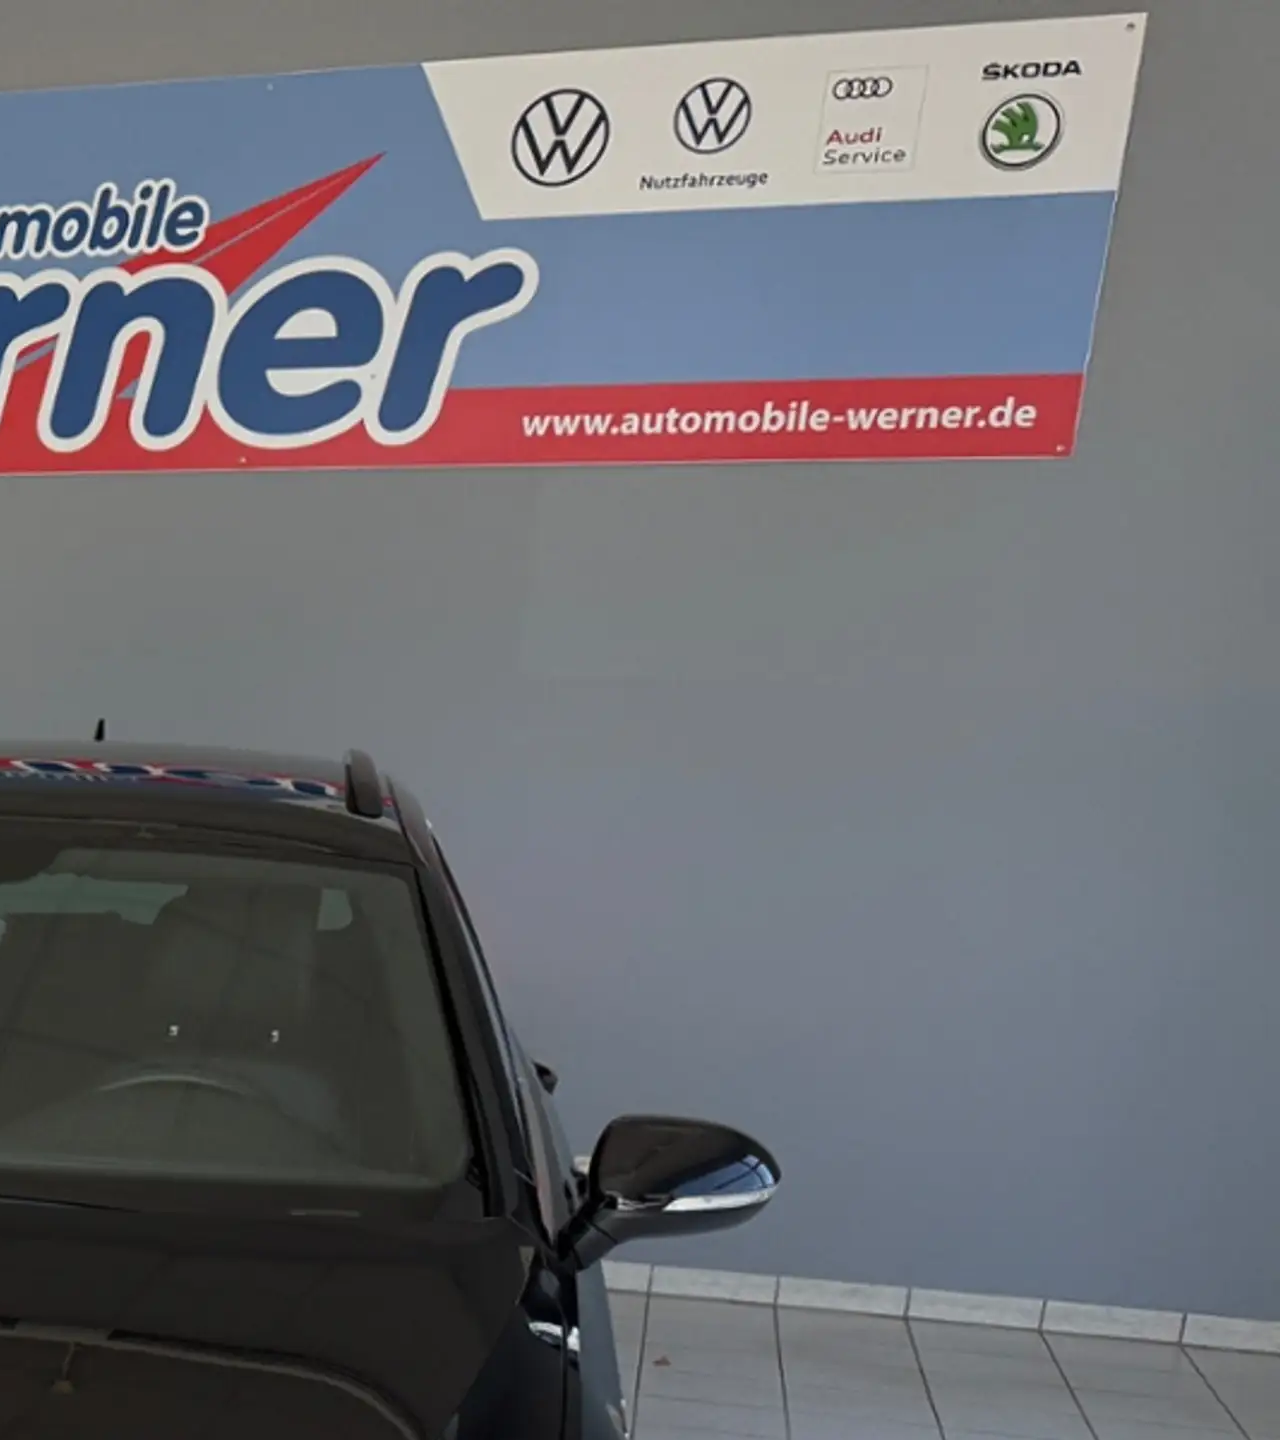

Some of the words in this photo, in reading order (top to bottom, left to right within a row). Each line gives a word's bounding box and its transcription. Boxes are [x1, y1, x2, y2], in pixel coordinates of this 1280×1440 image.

[826, 127, 882, 145] Audi
[822, 148, 906, 166] Service
[639, 171, 769, 191] Nutzfahrzeuge
[521, 397, 1037, 438] www.automobile-werner.de
